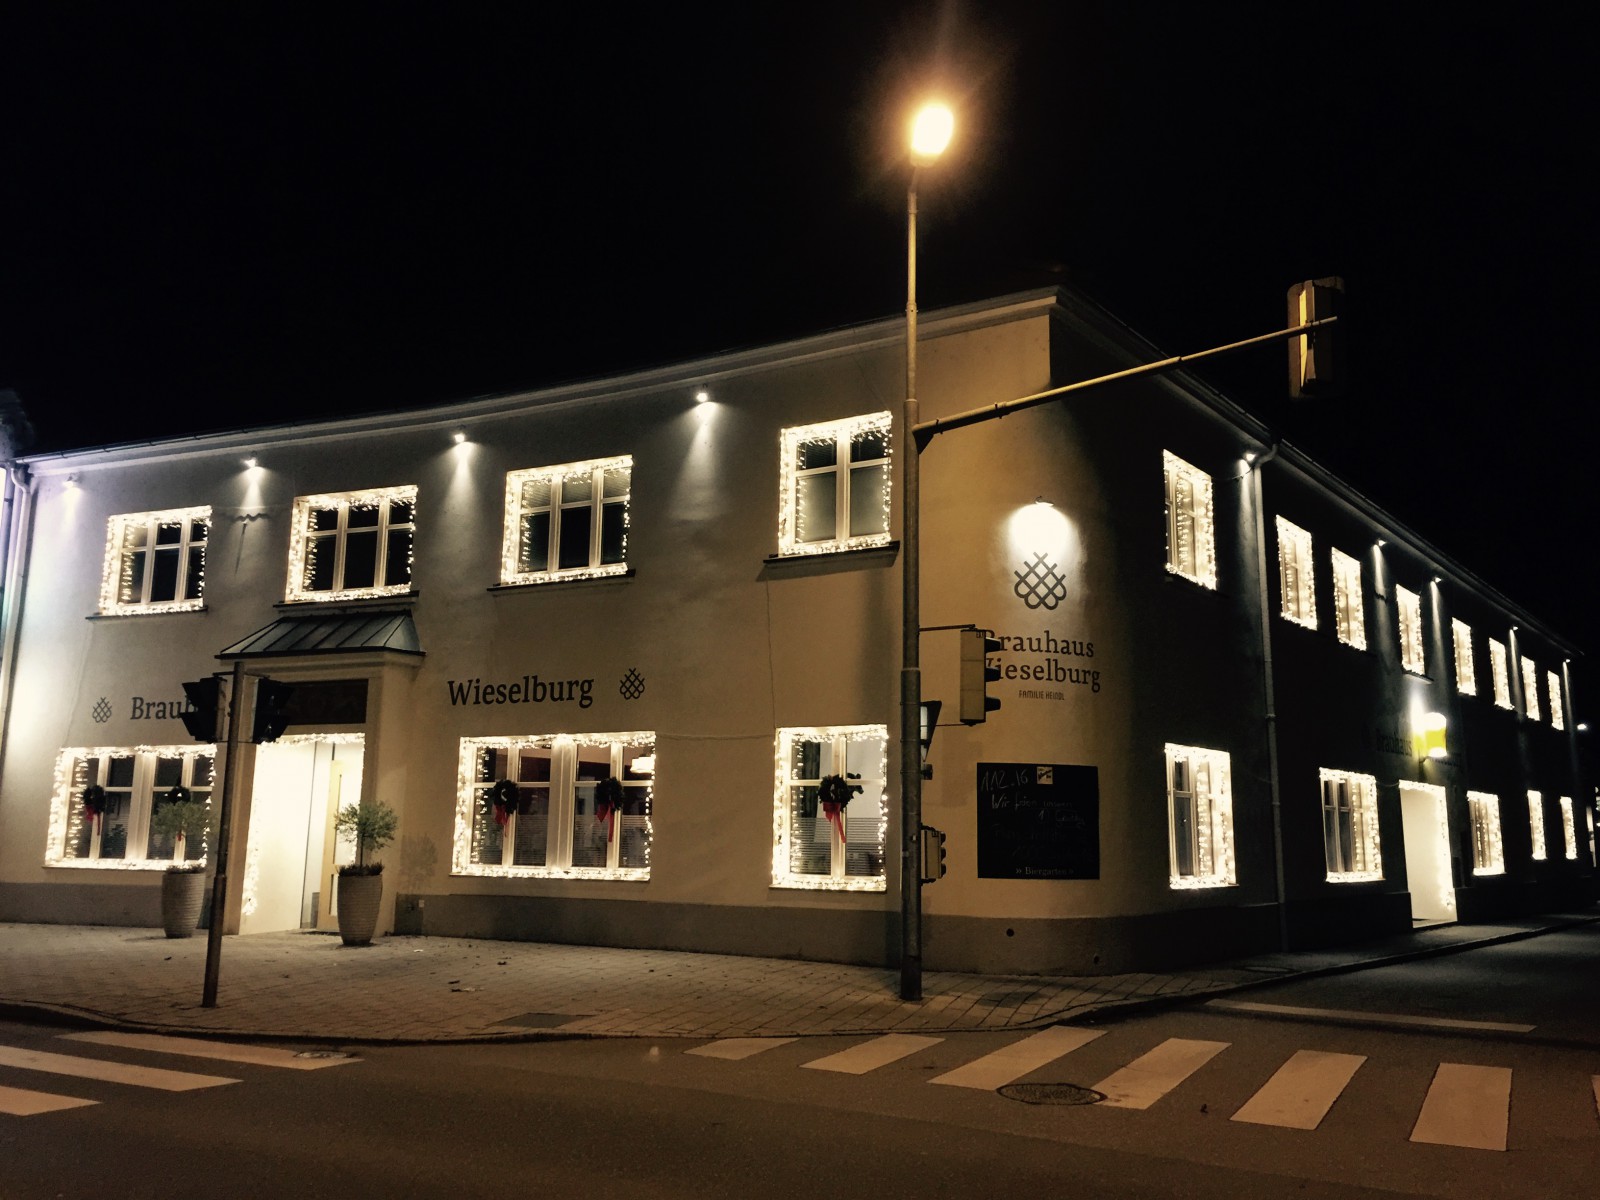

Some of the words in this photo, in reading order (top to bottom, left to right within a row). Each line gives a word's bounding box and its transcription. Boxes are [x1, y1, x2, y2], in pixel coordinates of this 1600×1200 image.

[985, 657, 1101, 692] ieselburg
[447, 674, 594, 709] Wieselburg
[1019, 689, 1044, 699] FAMILIE
[1024, 866, 1068, 877] Biergarten
